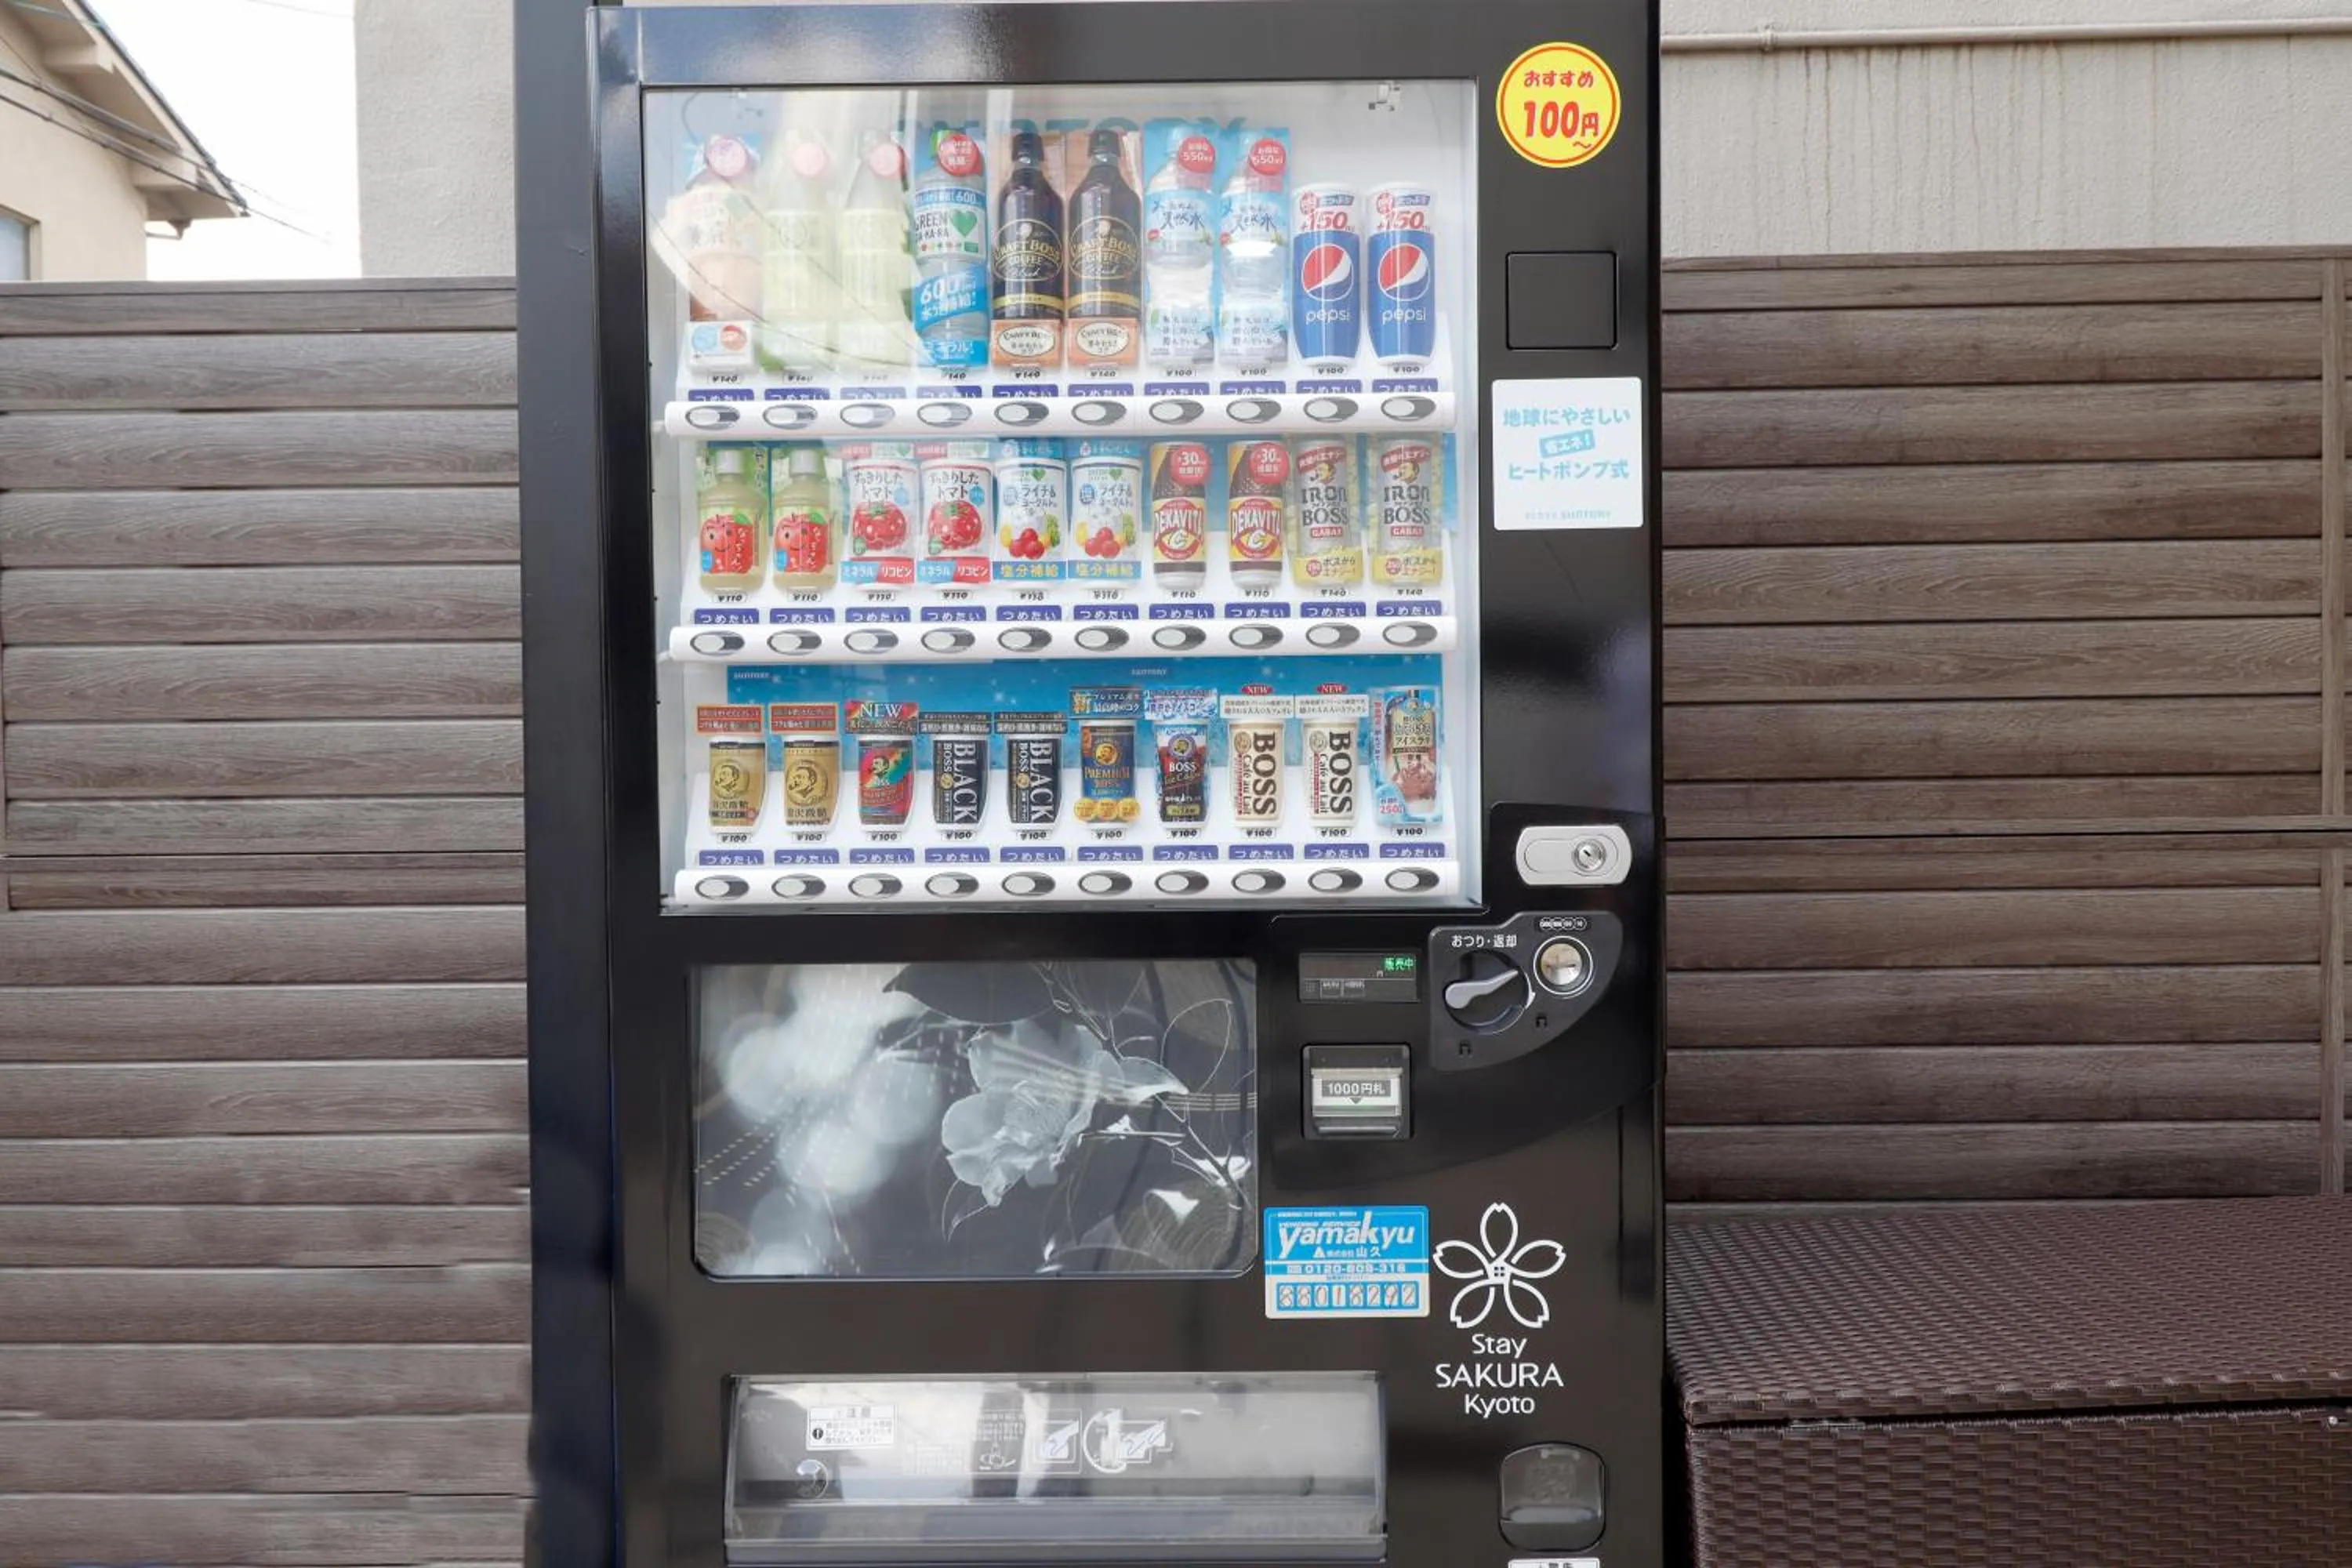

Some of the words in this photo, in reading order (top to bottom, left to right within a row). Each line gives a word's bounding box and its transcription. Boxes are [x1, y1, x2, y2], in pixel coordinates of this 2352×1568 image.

[1523, 70, 1594, 88] おすすめ
[1305, 307, 1351, 325] pepsi
[1381, 307, 1427, 325] pepsi
[1241, 368, 1266, 376] ¥100
[1503, 408, 1632, 426] 地球にやさしい
[1508, 459, 1630, 481] ヒートポンプ式
[861, 485, 892, 499] トマト
[938, 485, 968, 499] トマト
[1301, 485, 1348, 504] IRON
[1383, 485, 1430, 503] IRON
[1301, 507, 1349, 527] BOSS
[1383, 506, 1431, 525] BOSS
[881, 564, 913, 578] リコピン
[957, 564, 989, 577] リコピン
[717, 593, 742, 602] ¥110
[927, 613, 980, 622] つめたい
[1004, 612, 1056, 621] つめたい
[1080, 611, 1133, 620] つめたい
[1156, 610, 1209, 619] つめたい
[1231, 609, 1285, 619] つめたい
[1307, 608, 1360, 618] つめたい
[1383, 608, 1436, 617] つめたい
[701, 615, 753, 624] つめたい
[777, 615, 829, 624] つめたい
[852, 614, 905, 623] つめたい
[859, 702, 903, 718] NEW
[943, 742, 953, 772] BOSS
[1019, 742, 1029, 772] BOSS
[1169, 761, 1197, 773] BOSS
[1329, 730, 1353, 814] BOSS
[1253, 730, 1277, 815] BOSS
[953, 742, 978, 822] BLACK
[1029, 742, 1054, 822] BLACK
[946, 831, 972, 840] ¥100
[1020, 831, 1047, 840] ¥100
[1095, 830, 1122, 839] ¥100
[1171, 829, 1197, 838] ¥100
[1320, 828, 1347, 837] ¥100
[1396, 827, 1424, 836] ¥100
[932, 854, 984, 862] つめたい
[1007, 853, 1059, 862] つめたい
[1085, 853, 1138, 862] つめたい
[1160, 851, 1212, 860] つめたい
[1236, 851, 1287, 859] つめたい
[1311, 850, 1363, 858] つめたい
[1386, 849, 1439, 858] つめたい
[706, 856, 758, 865] つめたい
[782, 856, 833, 865] つめたい
[857, 855, 909, 863] つめたい
[1451, 934, 1518, 948] おつり・返却
[1327, 1082, 1386, 1095] 1000円札
[1278, 1210, 1415, 1259] yamakyu
[1472, 1334, 1527, 1358] Stay
[1436, 1363, 1565, 1388] SAKURA
[1465, 1394, 1535, 1418] Kyoto
